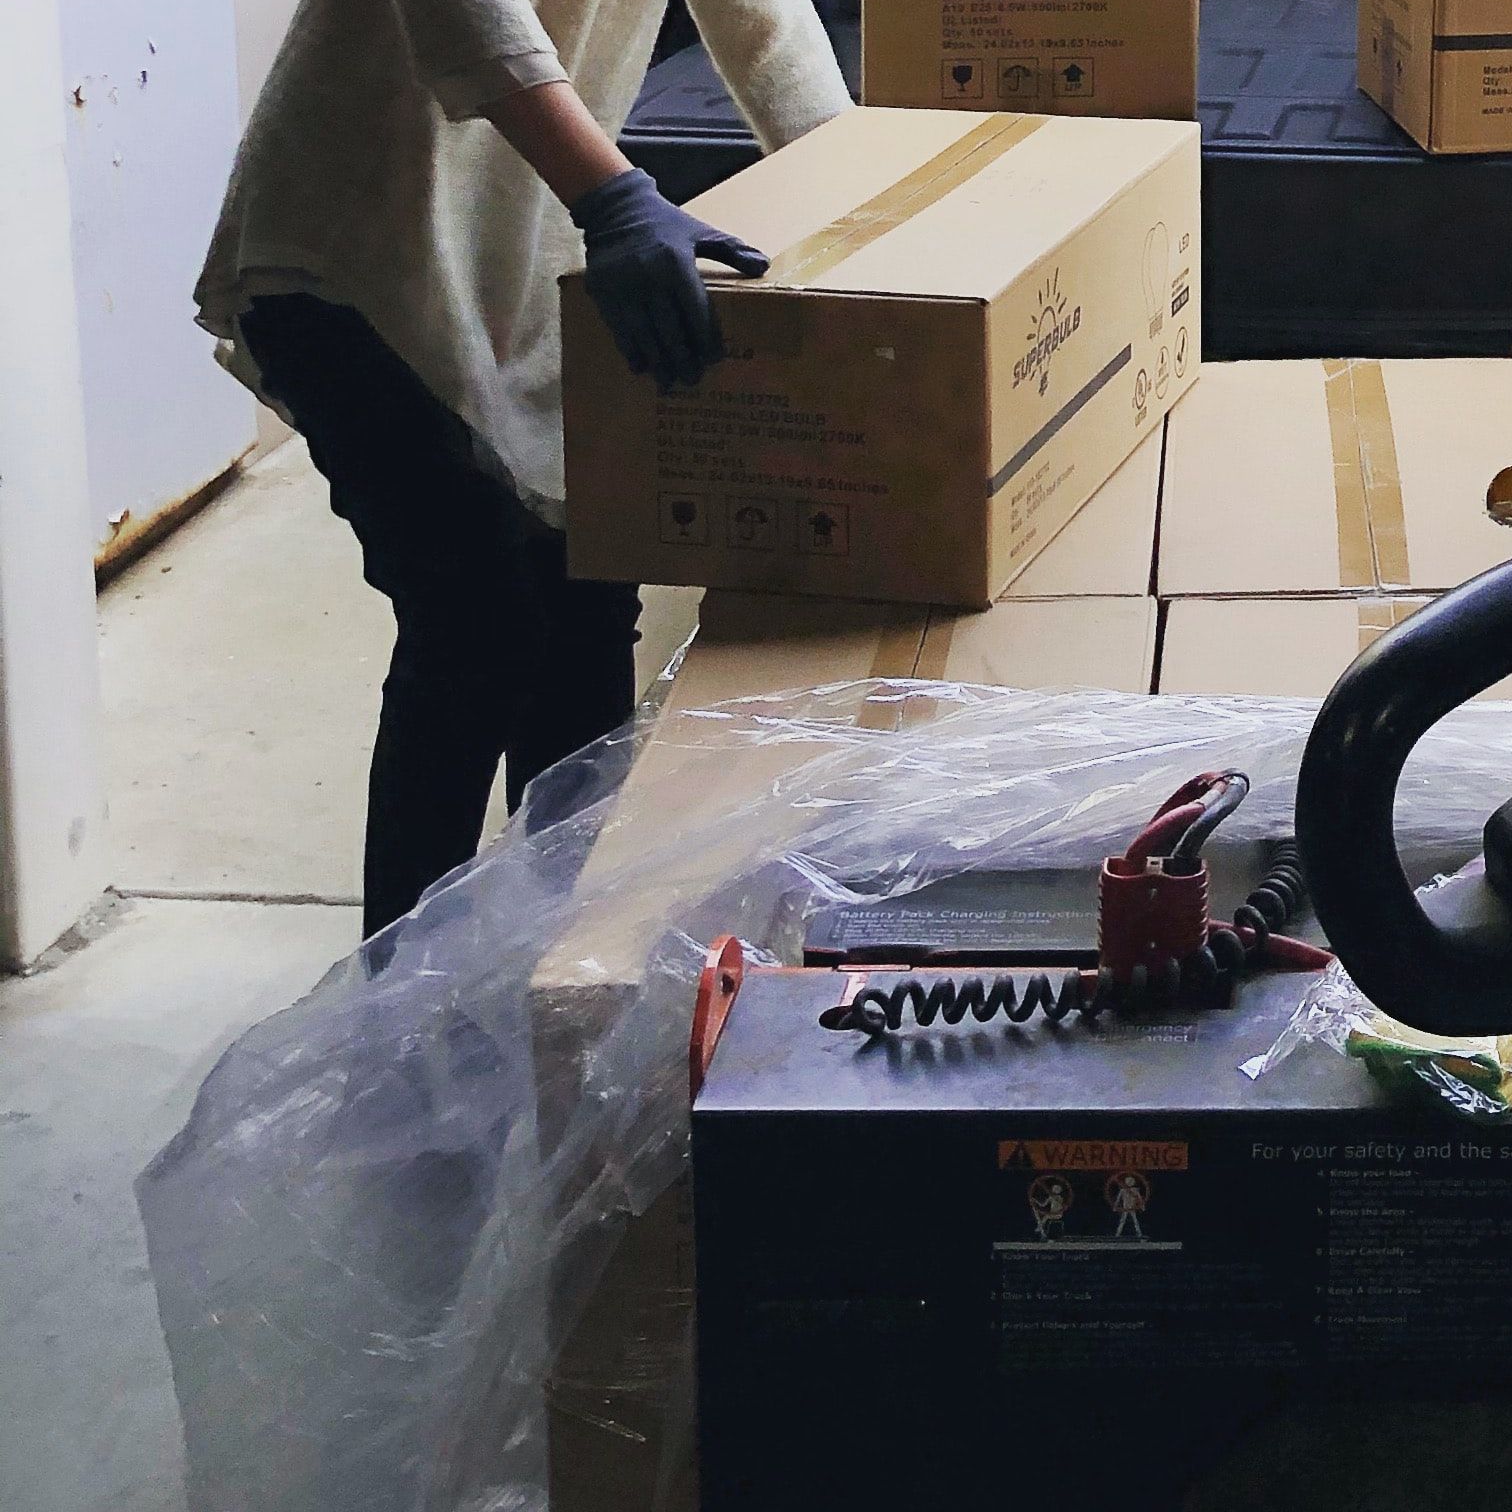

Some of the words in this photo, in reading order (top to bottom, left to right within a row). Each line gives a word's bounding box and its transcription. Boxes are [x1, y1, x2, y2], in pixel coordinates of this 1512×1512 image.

[1178, 232, 1190, 254] LED
[1012, 306, 1082, 389] SUPERBULB
[839, 910, 895, 922] Battery
[900, 909, 934, 920] Pack
[940, 909, 1008, 921] Charging
[1044, 1145, 1184, 1168] WARNING
[1252, 1143, 1285, 1159] For
[1291, 1146, 1337, 1163] your
[1345, 1141, 1406, 1163] safety
[1414, 1142, 1451, 1159] and
[1459, 1142, 1492, 1159] the
